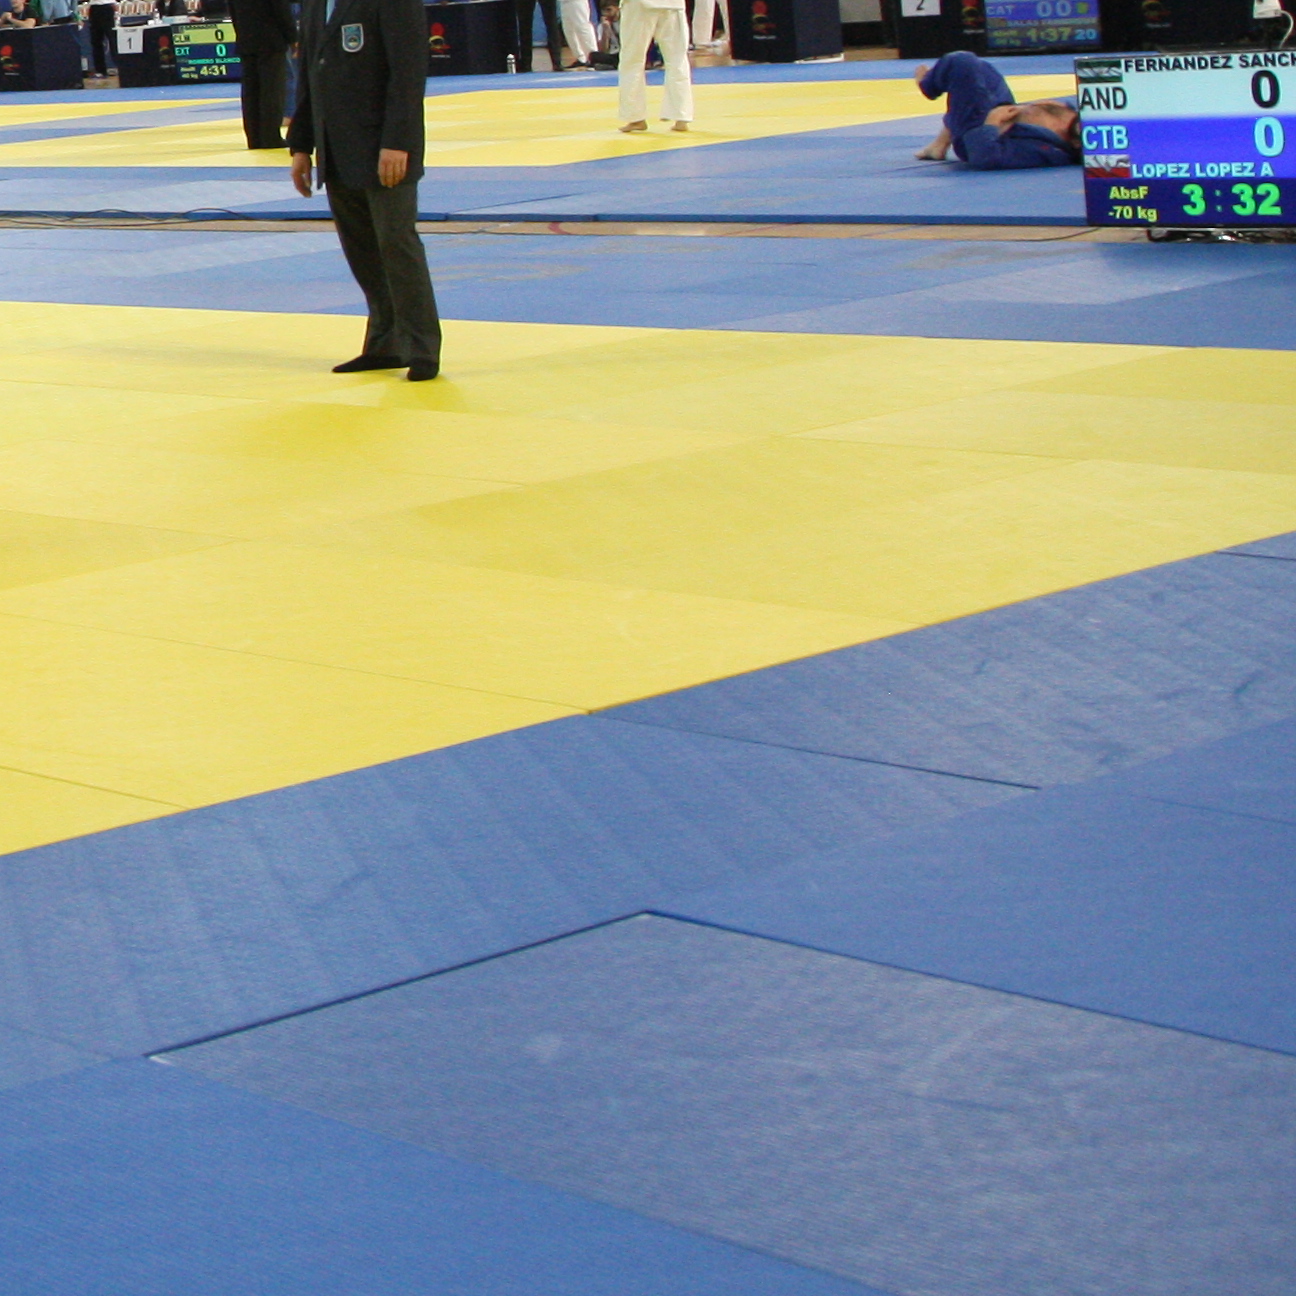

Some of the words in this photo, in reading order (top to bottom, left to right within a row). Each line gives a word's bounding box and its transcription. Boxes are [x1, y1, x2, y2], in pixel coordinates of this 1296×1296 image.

[986, 5, 1016, 16] CAT
[214, 29, 224, 42] 0
[1027, 27, 1072, 43] 1:37
[1074, 28, 1098, 41] 20
[174, 47, 190, 56] EXT
[216, 44, 227, 57] 0
[200, 65, 228, 77] 4:31
[1124, 55, 1232, 73] FERNANDEZ
[1079, 86, 1127, 111] AND
[1251, 69, 1282, 109] 0
[1082, 124, 1129, 151] CTB
[1253, 116, 1285, 157] 0
[1132, 163, 1191, 178] LOPEZ
[1195, 162, 1256, 178] LOPEZ
[1260, 161, 1275, 178] A
[1109, 186, 1149, 200] AbsF
[1109, 205, 1133, 220] -70
[1137, 205, 1158, 222] kg
